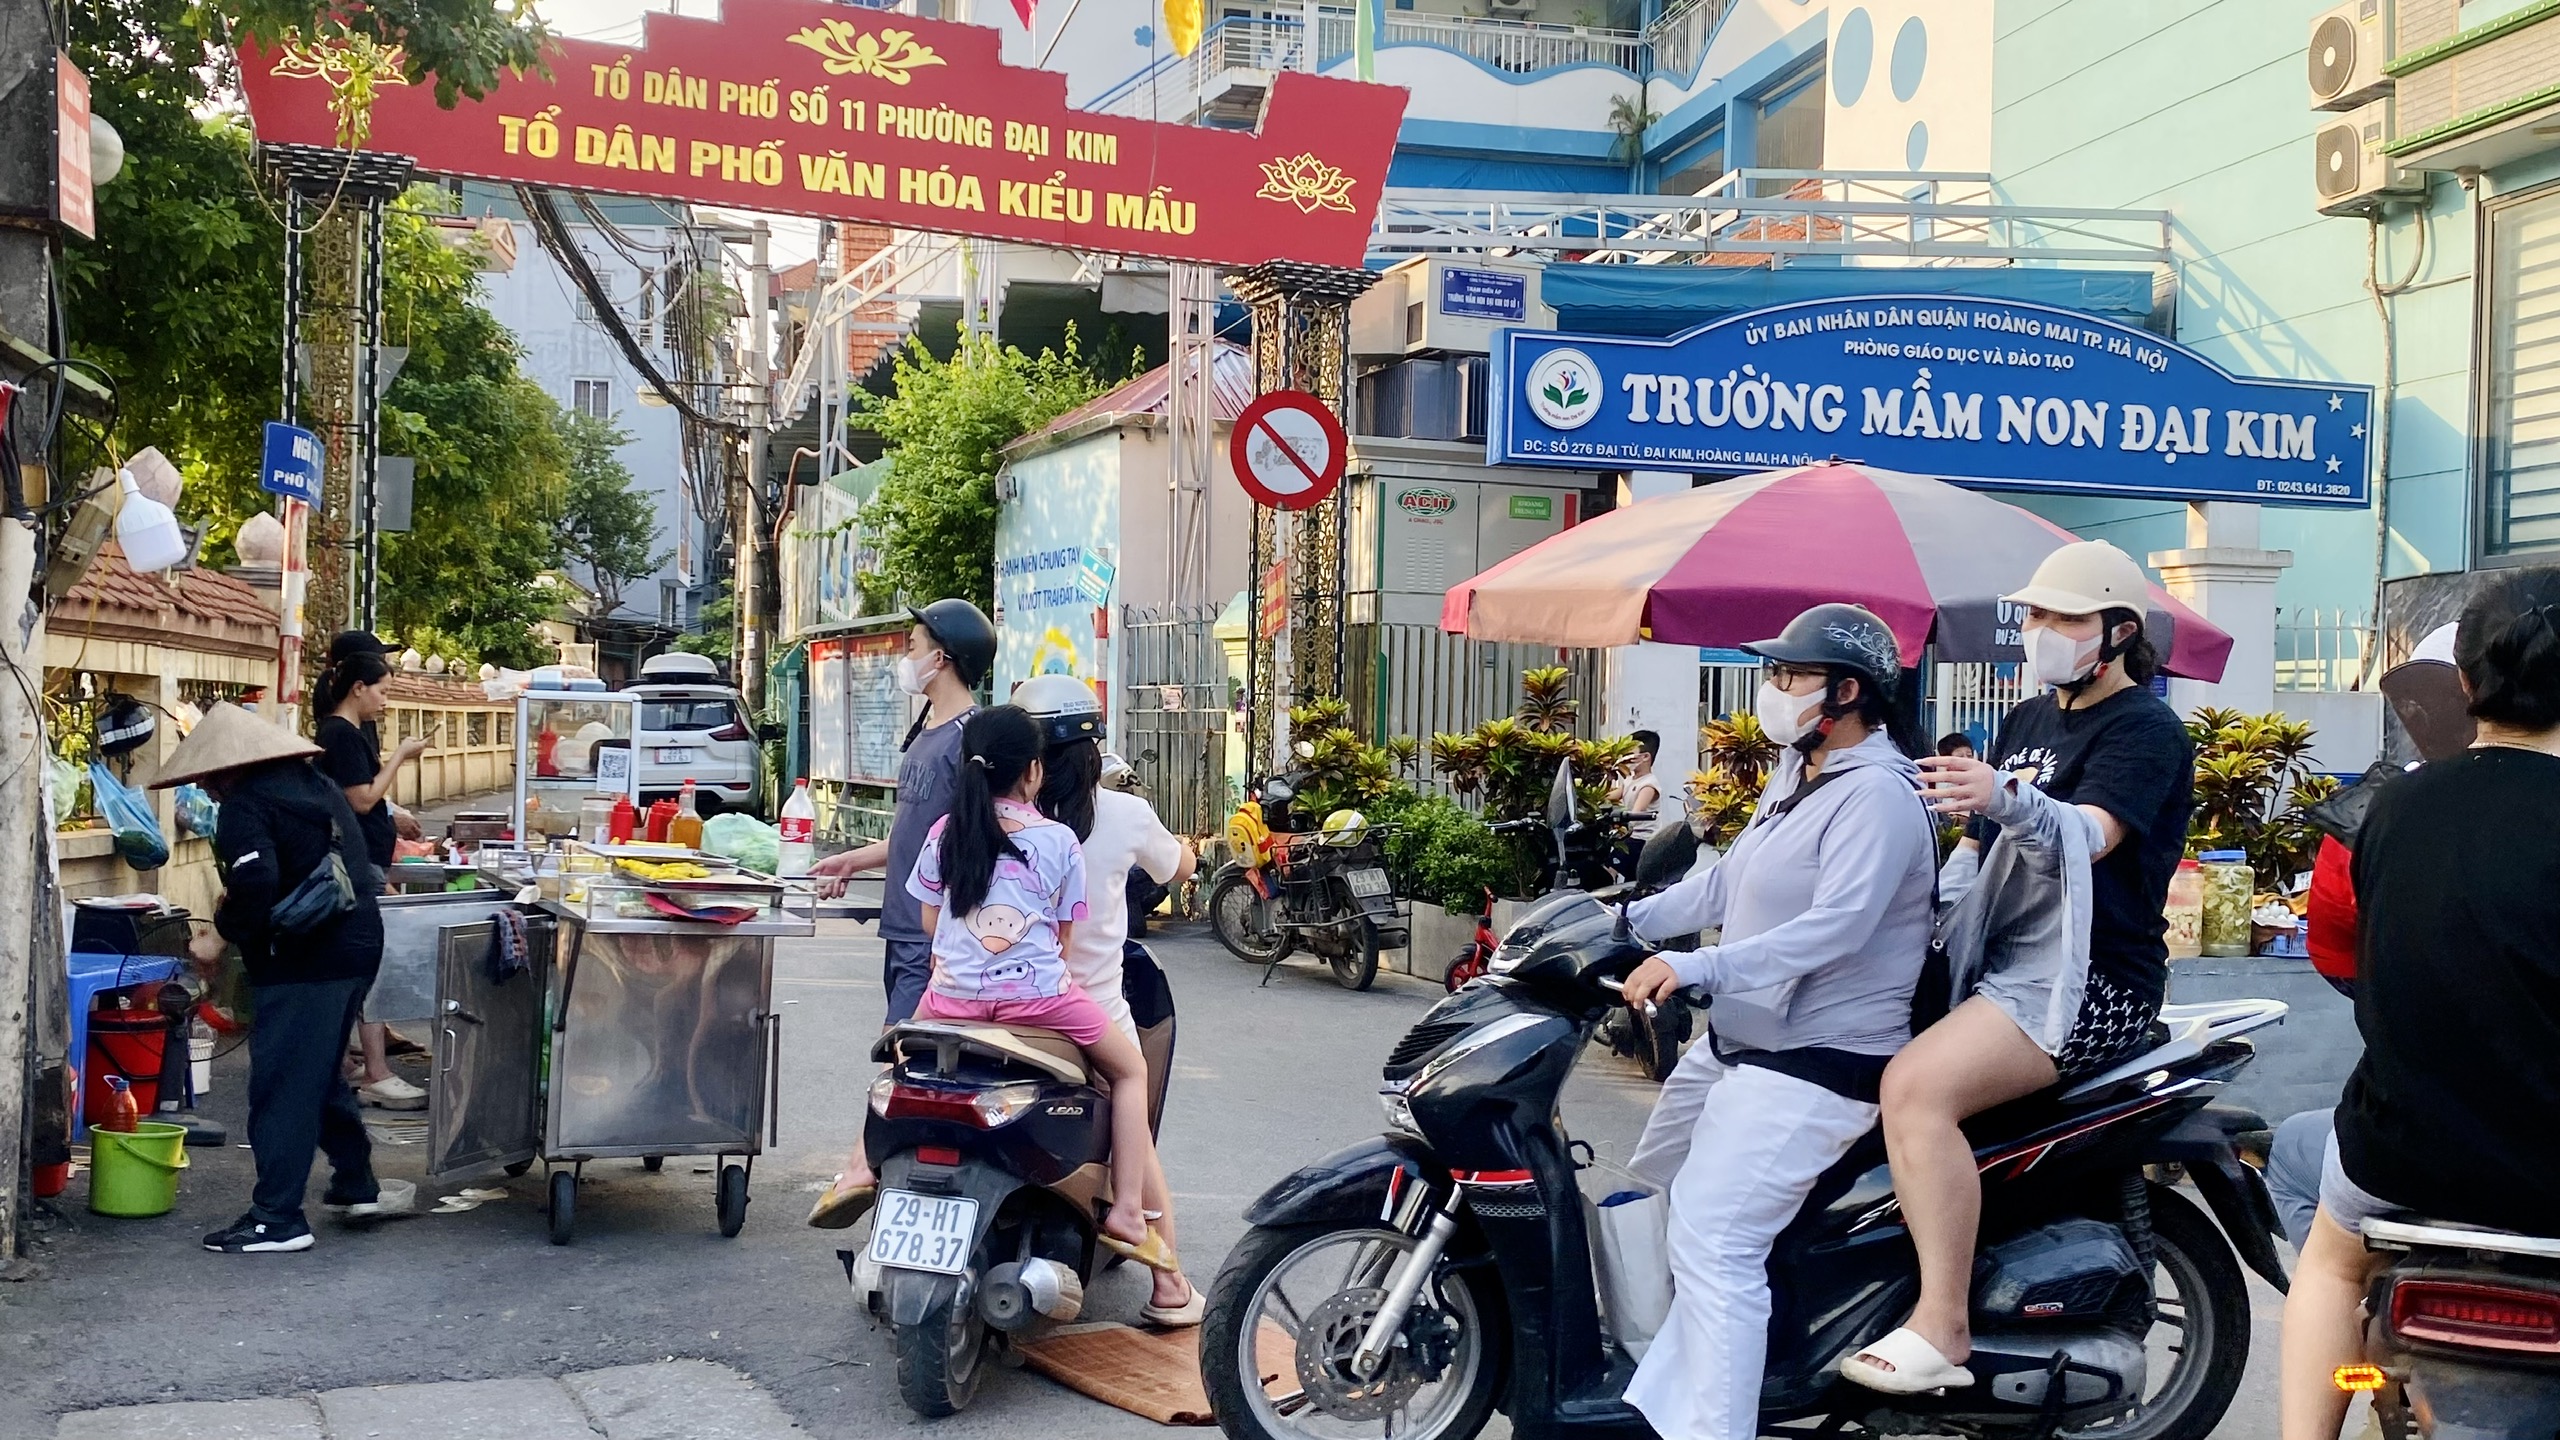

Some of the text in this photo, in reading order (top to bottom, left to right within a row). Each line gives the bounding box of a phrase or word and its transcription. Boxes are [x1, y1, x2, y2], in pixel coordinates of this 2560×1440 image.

[591, 54, 1118, 165] TỔ DÂN PHỐ SỐ 11 PHƯỜNG ĐẠI KIM
[497, 104, 1197, 236] TỔ DÂN PHỐ VĂN HÓA KIỂU MẪU
[1745, 306, 2168, 373] ỦY BAN NHÂN DÂN QUẬN HOÀNG MAI TP. HÀ NỘI
[1844, 337, 2074, 372] PHÒNG GIÁO DỤC VÀ ĐÀO TẠO
[1622, 363, 2317, 464] TRƯỜNG MẦM NON ĐẠI KIM
[1523, 439, 1547, 452] ĐC:
[1550, 436, 1569, 453] SỐ
[1571, 443, 1593, 455] 276
[1596, 444, 1618, 458] ĐẠI
[1643, 446, 1665, 460] ĐẠI
[1696, 447, 1741, 462] HOÀNG
[1402, 494, 1451, 509] ACIT
[2257, 479, 2276, 491] ĐT:
[994, 557, 1020, 579] THANH
[1039, 548, 1066, 571] CHUNG
[1066, 545, 1081, 566] TAY
[1045, 1105, 1084, 1116] LEAD
[890, 1196, 961, 1233] 29-H1
[876, 1229, 964, 1268] 678.37
